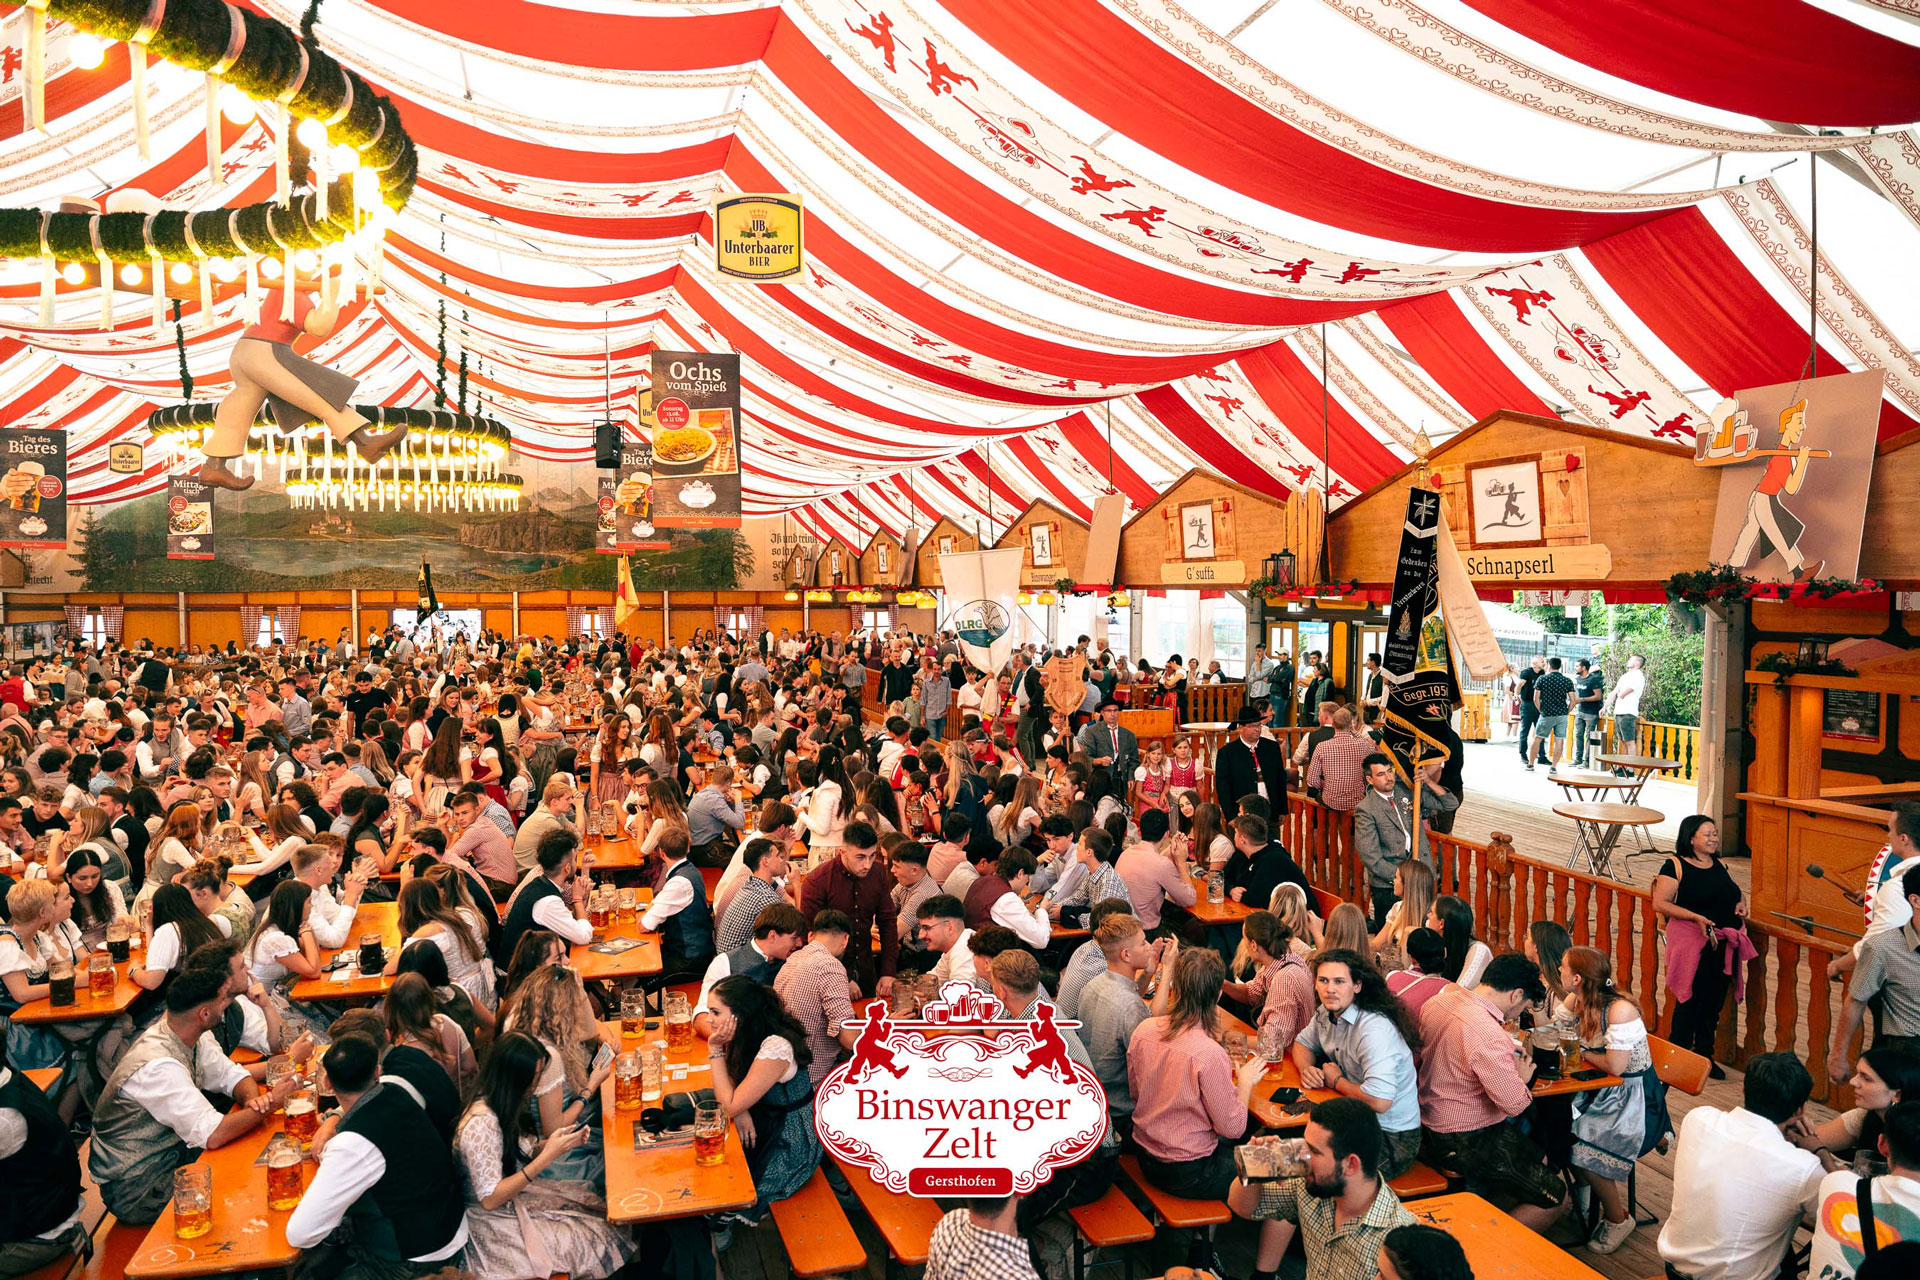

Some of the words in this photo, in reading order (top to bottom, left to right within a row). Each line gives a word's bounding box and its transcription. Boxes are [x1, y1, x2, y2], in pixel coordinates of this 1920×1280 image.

[752, 220, 766, 231] UB
[724, 239, 794, 255] Unterbaarer
[749, 256, 770, 267] BIER
[669, 361, 722, 381] Ochs
[665, 382, 691, 391] vom
[694, 381, 727, 394] Spieß
[23, 435, 37, 444] Tag
[37, 435, 51, 443] des
[8, 440, 58, 455] Bieres
[622, 453, 653, 465] Biere
[1467, 554, 1555, 579] Schnapserl
[955, 619, 983, 630] DLRG
